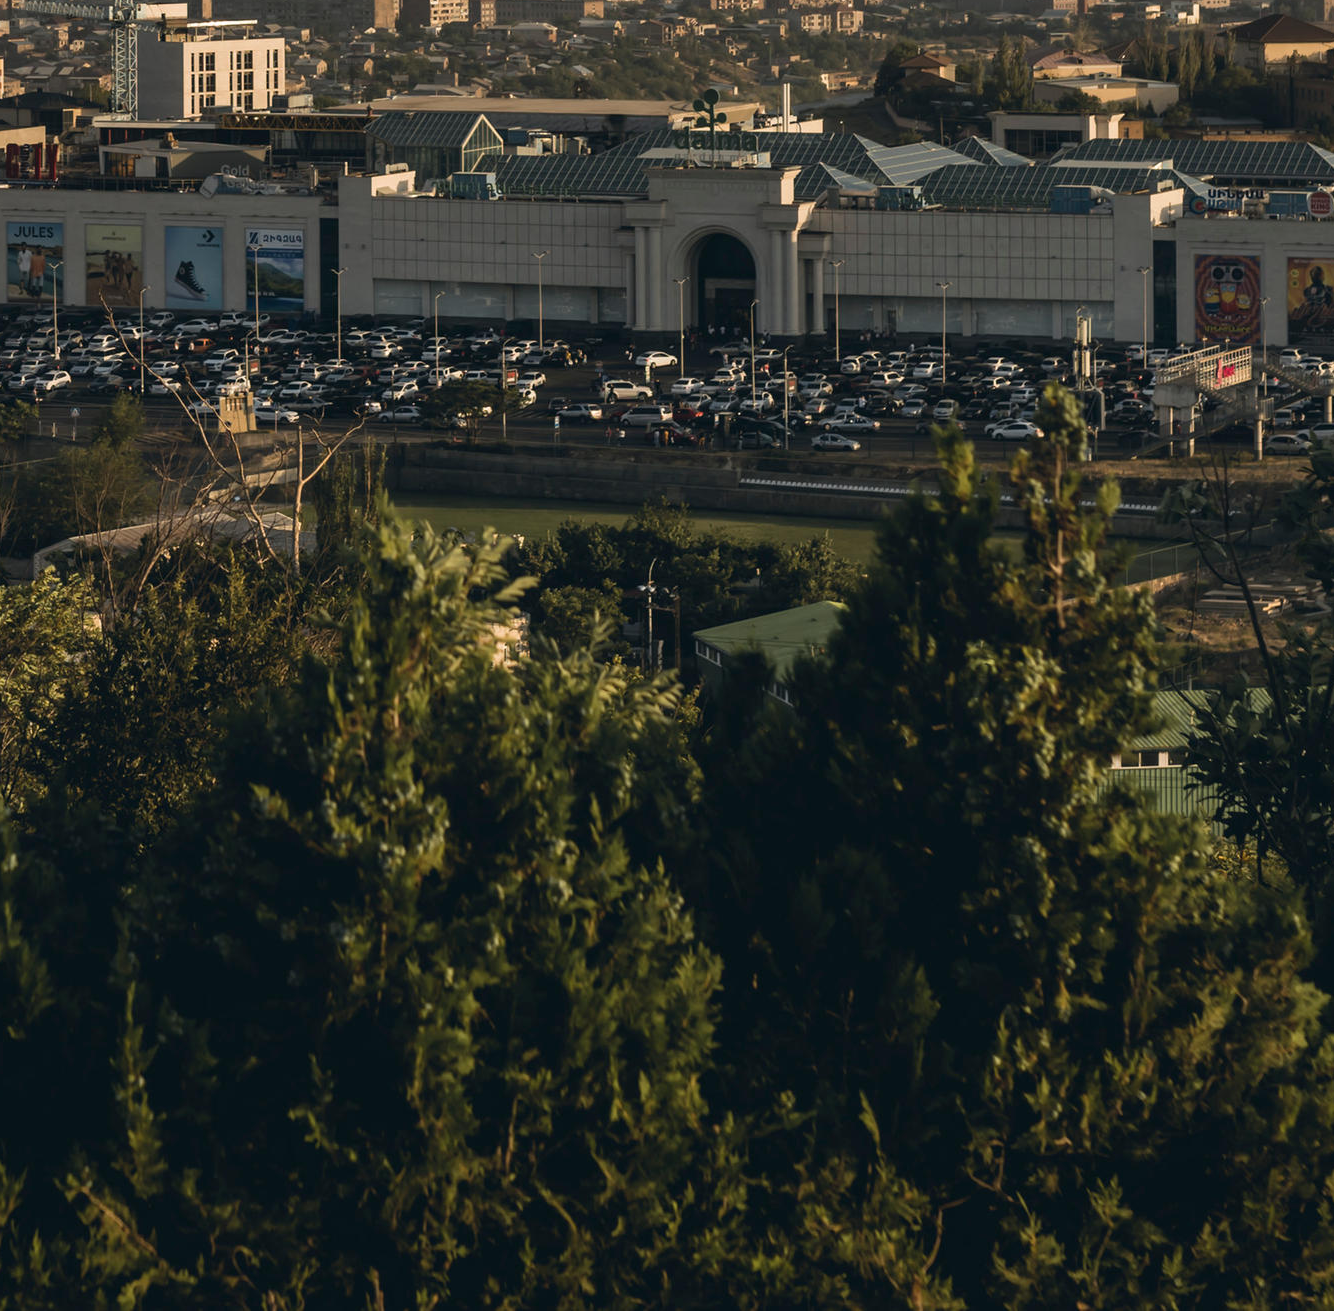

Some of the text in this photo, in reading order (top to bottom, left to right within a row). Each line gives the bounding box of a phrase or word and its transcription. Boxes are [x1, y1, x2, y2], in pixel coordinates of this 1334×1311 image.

[221, 164, 250, 176] Gold
[14, 226, 54, 238] JULES
[263, 234, 302, 243] ԶԻԳԶԱԳ
